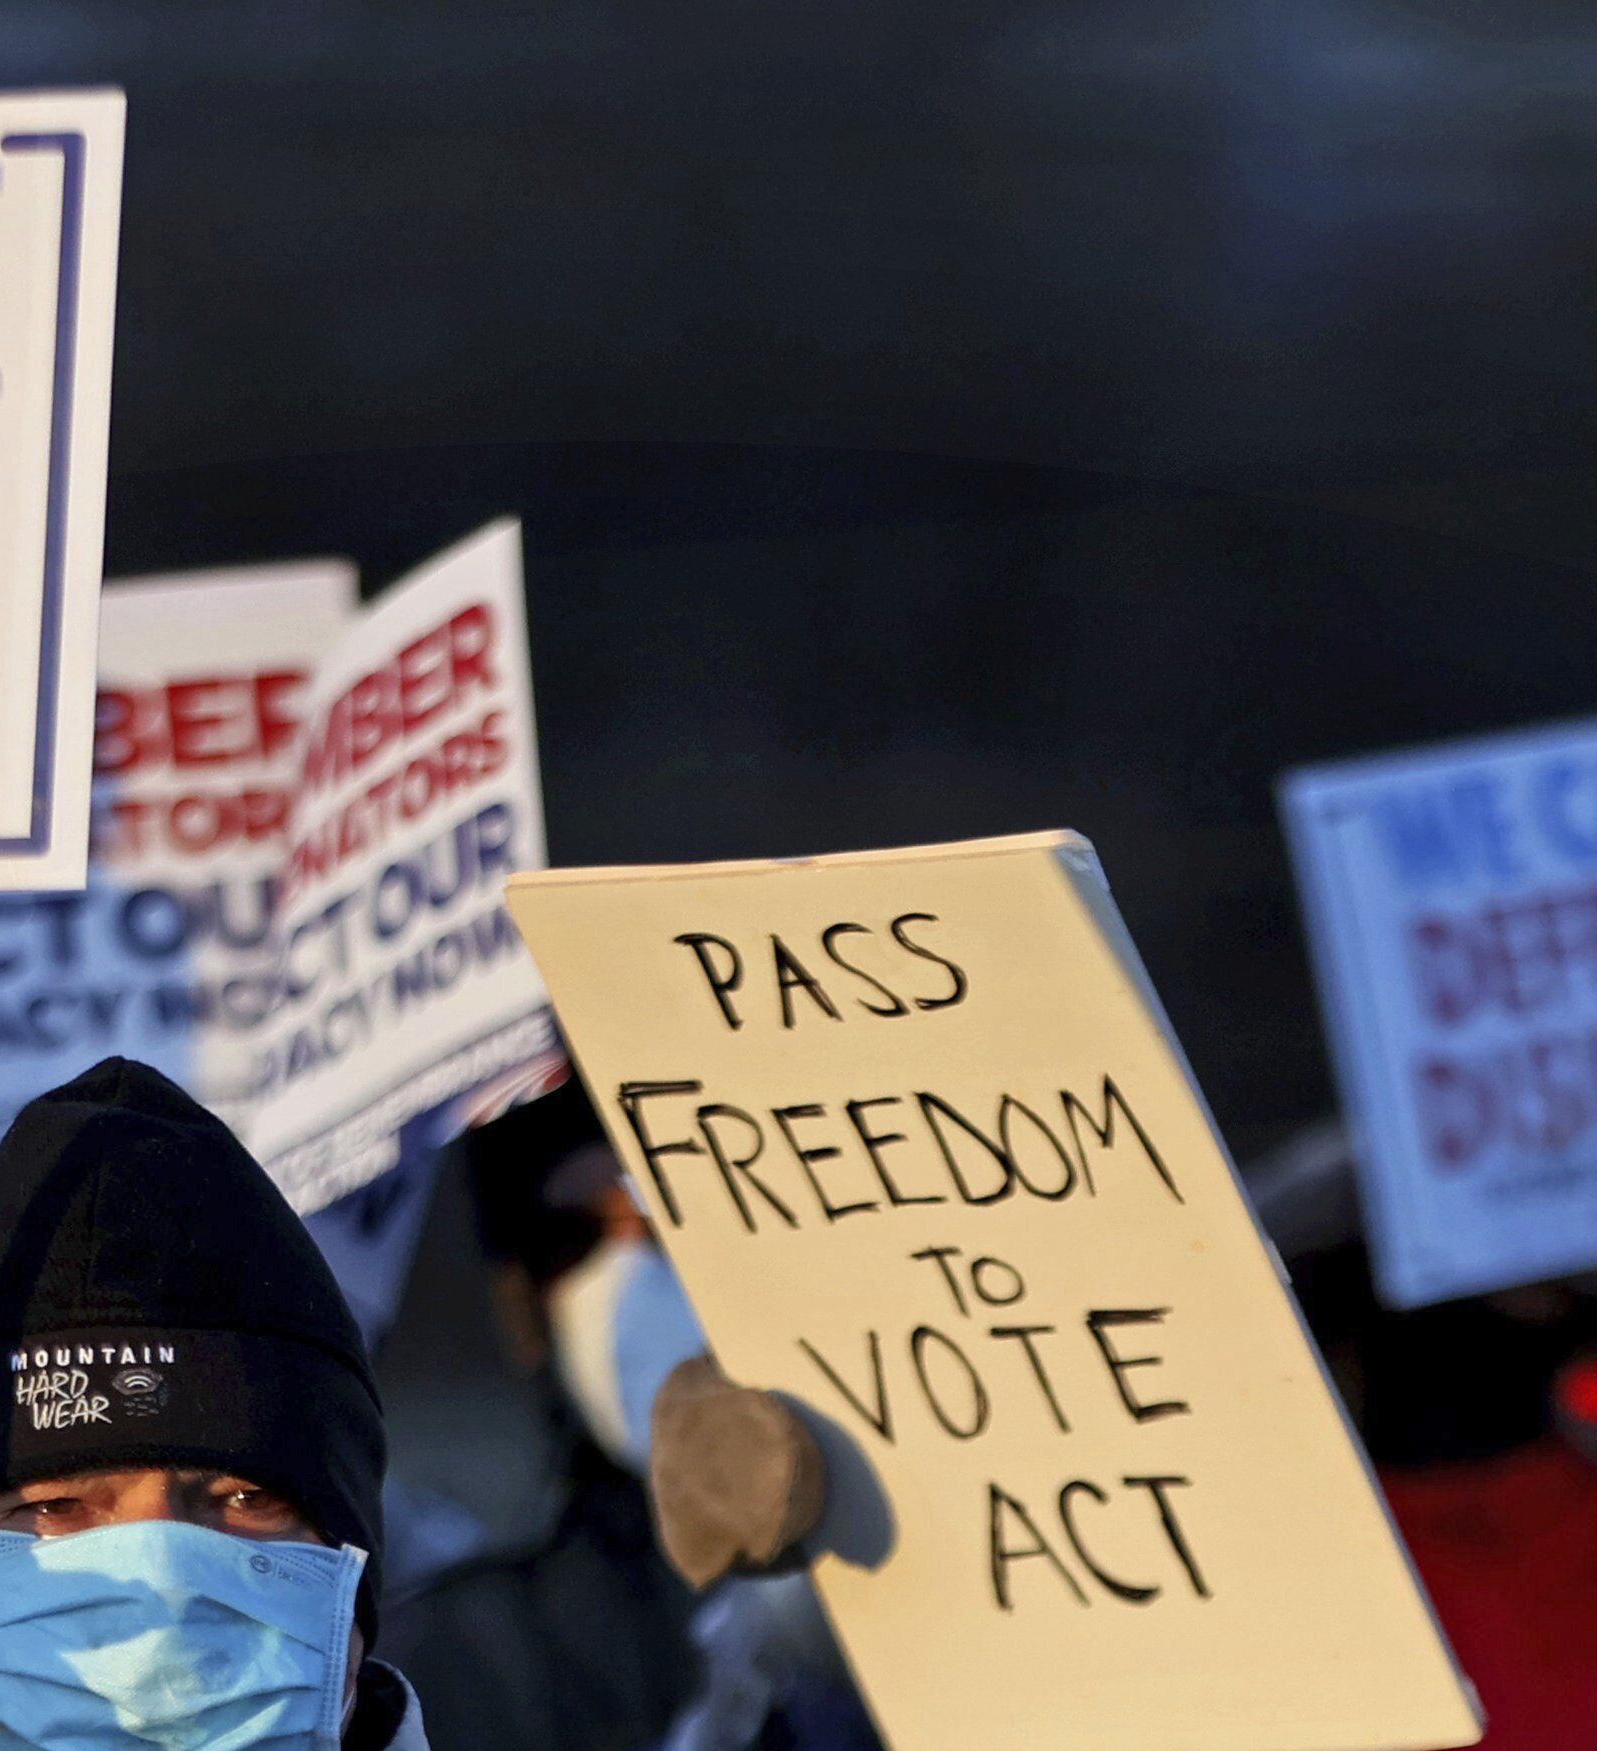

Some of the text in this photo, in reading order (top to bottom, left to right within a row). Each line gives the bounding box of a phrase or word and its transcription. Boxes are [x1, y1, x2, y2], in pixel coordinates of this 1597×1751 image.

[673, 911, 969, 1031] PASS
[617, 1072, 1185, 1235] FREEDOM
[908, 1243, 1025, 1318] TO
[10, 1346, 176, 1372] MOUNTAIN
[15, 1368, 89, 1406] HARD
[796, 1306, 1192, 1445] VOTE
[31, 1395, 114, 1431] WEAR
[985, 1474, 1215, 1613] ACT
